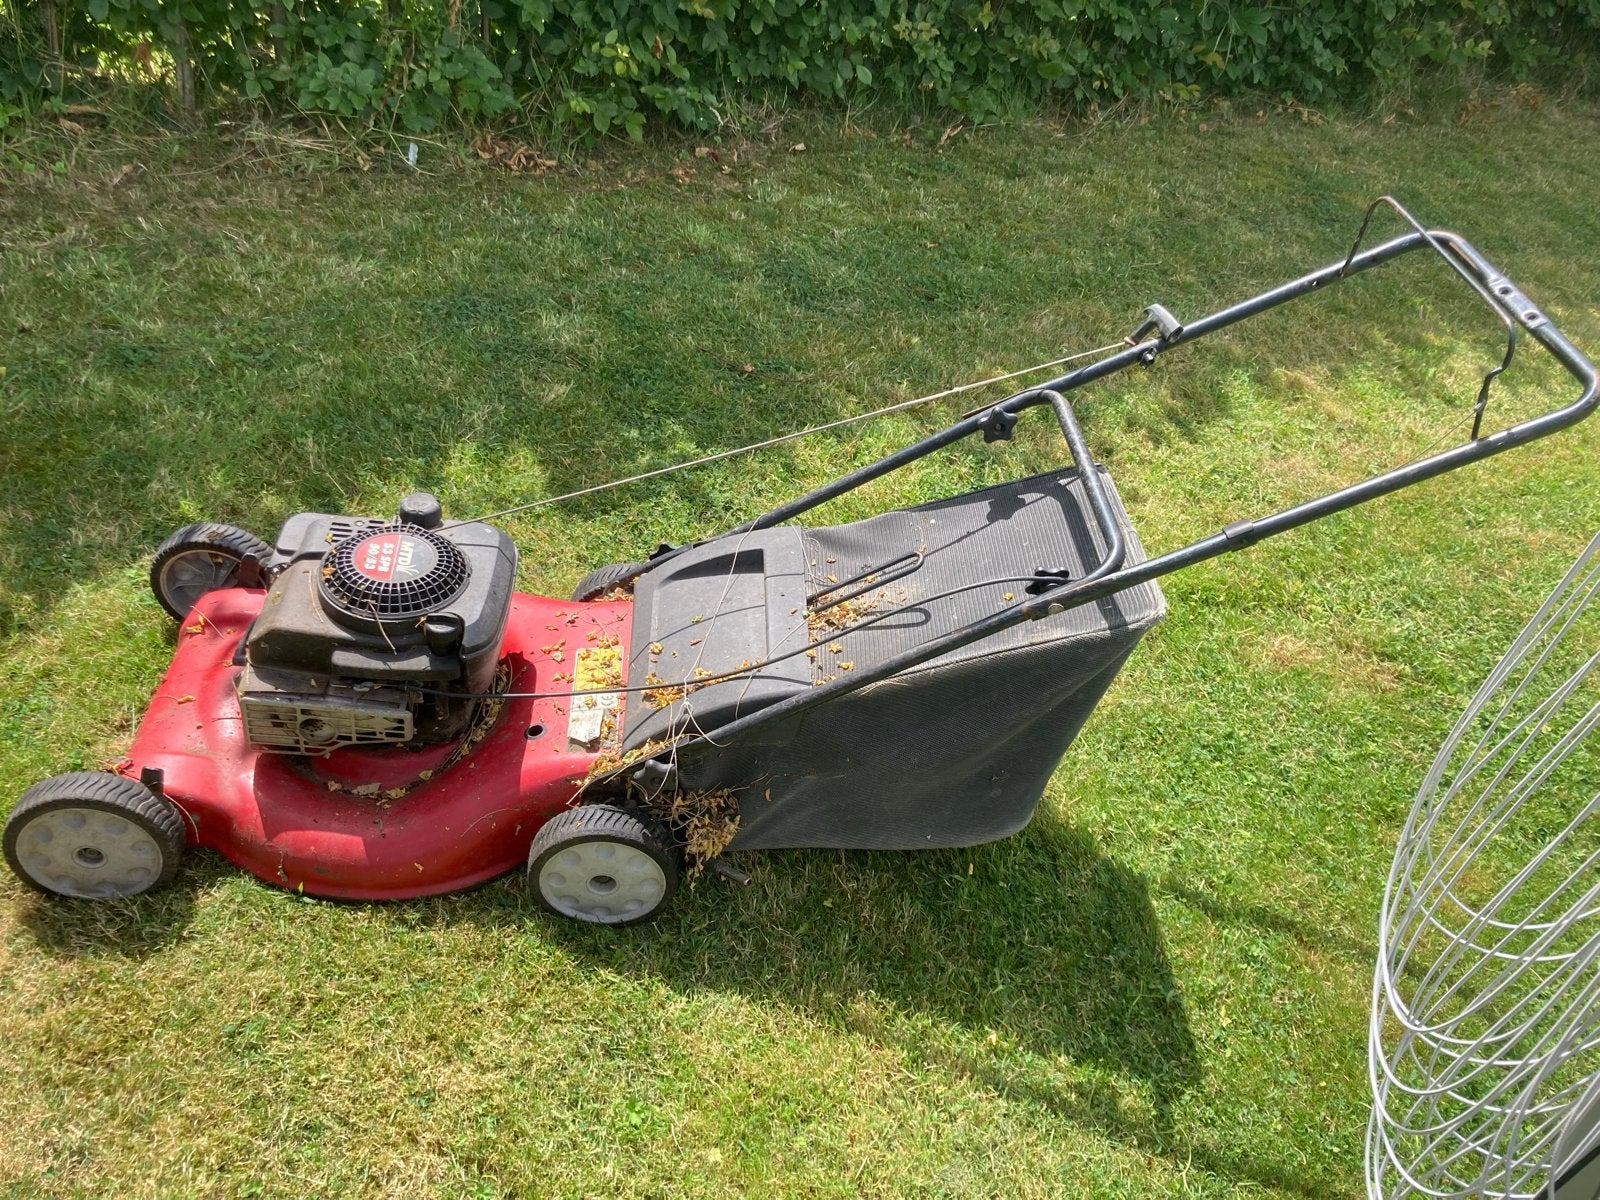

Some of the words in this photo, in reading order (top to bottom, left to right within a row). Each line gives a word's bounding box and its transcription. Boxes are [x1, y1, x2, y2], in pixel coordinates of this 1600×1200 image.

[363, 543, 381, 570] 50/53
[382, 542, 395, 555] 53
[397, 541, 415, 566] MTD
